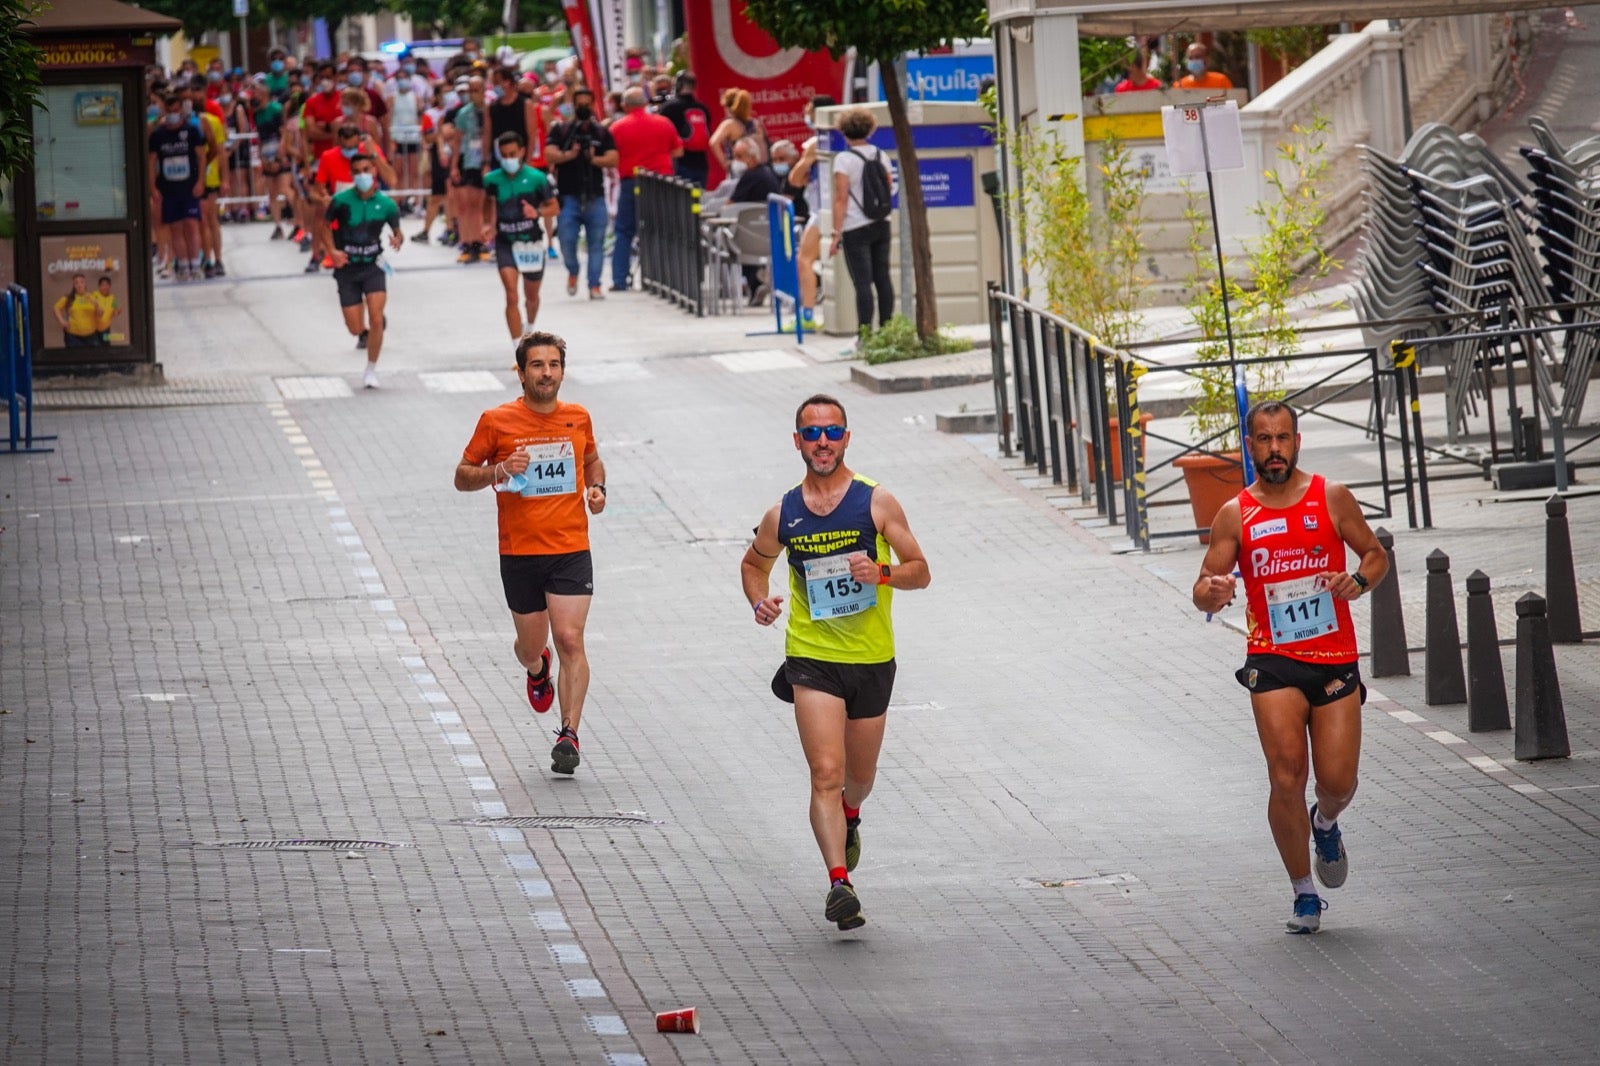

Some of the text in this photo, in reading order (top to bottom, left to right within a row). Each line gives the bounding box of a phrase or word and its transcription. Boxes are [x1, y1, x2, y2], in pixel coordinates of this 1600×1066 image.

[1184, 109, 1198, 121] 38
[534, 461, 566, 480] 144
[536, 485, 563, 495] FRANCISCO
[790, 530, 860, 543] ATLETISMO
[1251, 547, 1329, 578] Polisalud
[825, 578, 862, 598] 153
[832, 603, 859, 615] ANSELMO
[1285, 598, 1320, 623] 117
[1294, 627, 1319, 639] ANTONIO
